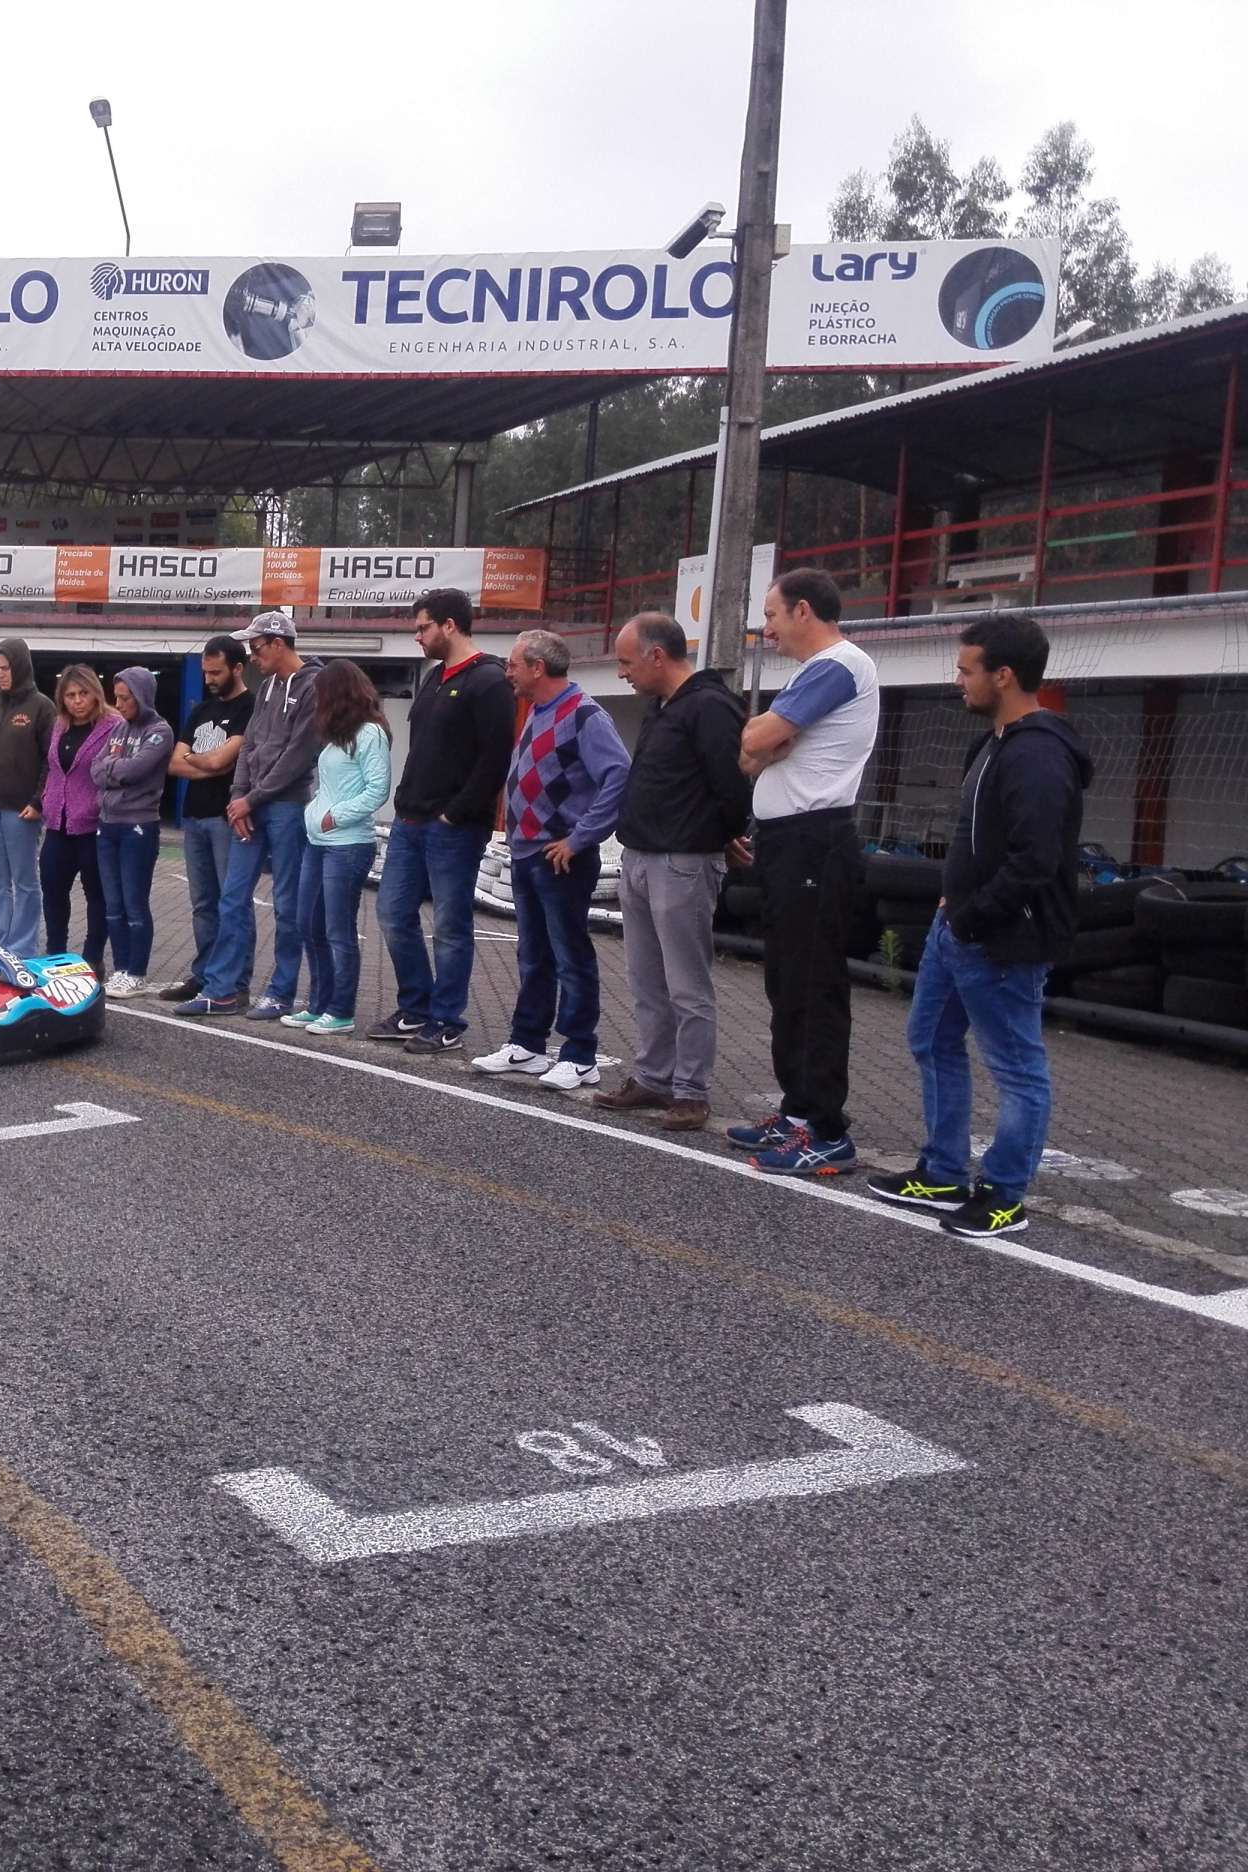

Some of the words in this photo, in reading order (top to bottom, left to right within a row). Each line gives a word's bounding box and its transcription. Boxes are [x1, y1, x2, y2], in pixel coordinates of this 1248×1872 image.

[132, 272, 202, 292] HURON
[342, 260, 735, 325] TECNIROLO
[810, 299, 870, 316] INJEÇÃO
[93, 311, 149, 321] CENTROS
[808, 316, 876, 330] PLÁSTICO
[92, 324, 176, 339] MAQUINAÇÃO
[91, 342, 122, 352] ALTA
[125, 342, 202, 352] VELOCIDADE
[388, 339, 508, 353] ENGENHARIA
[518, 337, 638, 351] INDUSTRIAL,
[807, 334, 815, 346] E
[819, 333, 897, 345] BORRACHA
[59, 549, 93, 557] Precisão
[266, 551, 286, 559] Mais
[288, 551, 298, 559] de
[486, 551, 526, 560] Precisão
[118, 554, 218, 577] HASCO
[329, 556, 435, 579] HASCO
[118, 586, 172, 600] Enabling
[175, 587, 200, 598] with
[203, 587, 254, 601] System.
[327, 588, 385, 603] Enabling
[389, 590, 415, 600] with
[515, 1420, 669, 1475] 18
